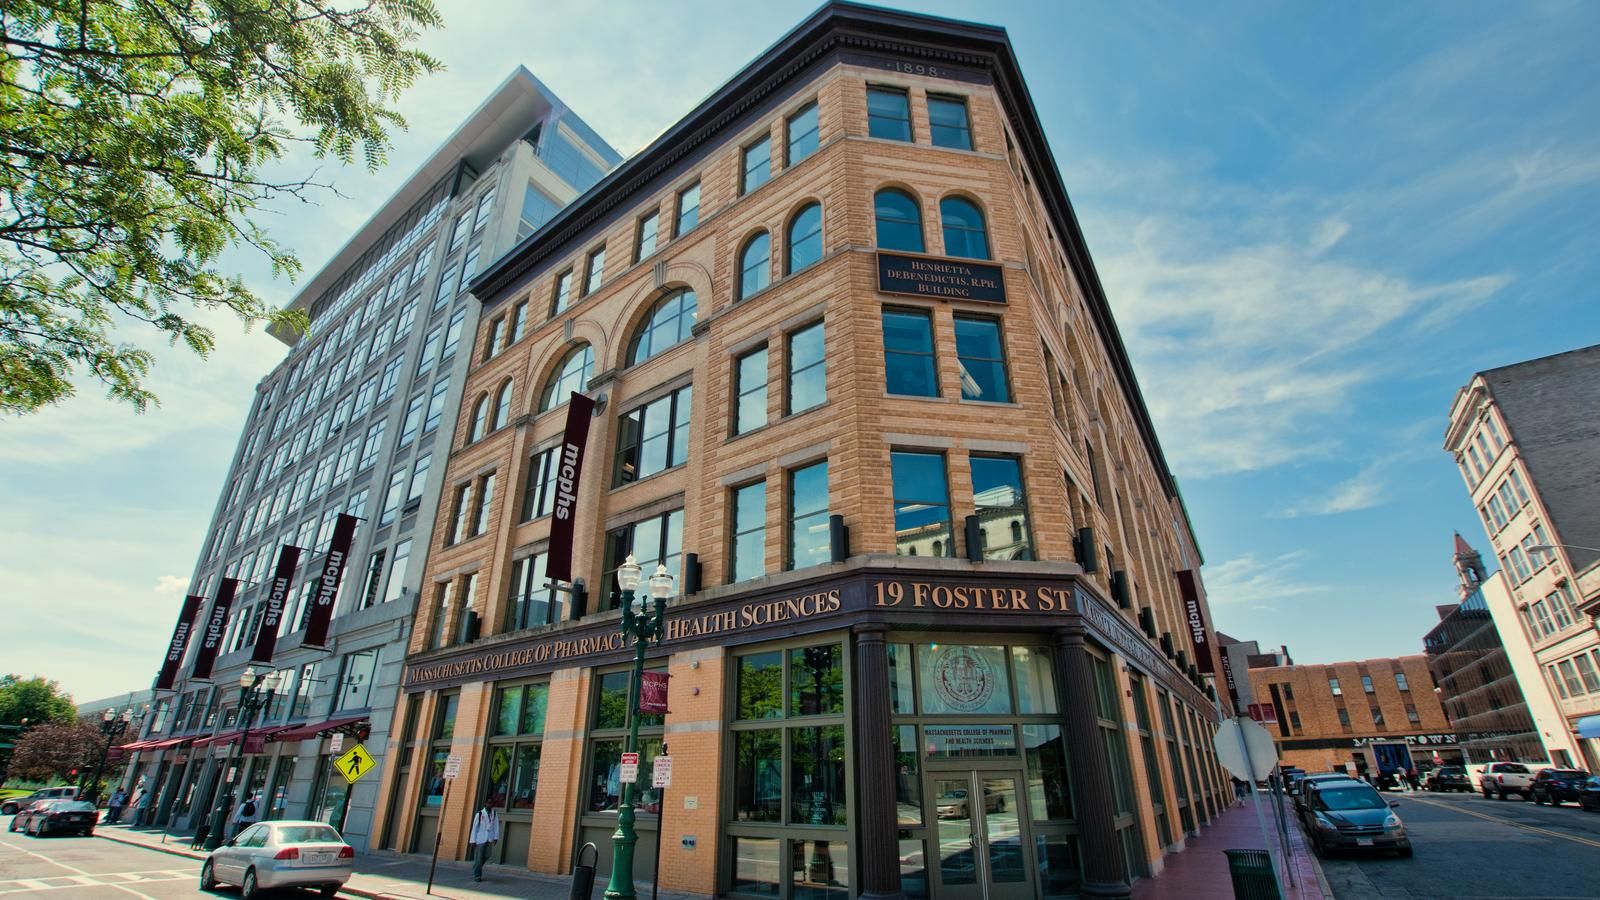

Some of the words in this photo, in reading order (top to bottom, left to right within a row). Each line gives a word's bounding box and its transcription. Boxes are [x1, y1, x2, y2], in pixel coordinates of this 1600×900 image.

[895, 61, 938, 77] 1898
[911, 261, 971, 276] HENRIETTA
[918, 283, 969, 297] BUILDING
[556, 442, 579, 521] mcphs
[318, 550, 344, 606] mcphs
[873, 581, 904, 607] 19
[911, 583, 1031, 610] FOSTER
[1036, 586, 1071, 611] ST
[265, 577, 288, 627] mcphs
[1187, 600, 1205, 644] mcphs
[169, 622, 190, 662] mcphs
[205, 605, 226, 649] mcphs
[411, 658, 484, 683] MASSACHUSETTS
[484, 649, 534, 671] COLLEGE
[534, 643, 554, 661] OF
[554, 631, 626, 659] PHARMACY
[666, 610, 737, 640] HEALTH
[741, 589, 841, 628] SCIENCES
[1221, 656, 1235, 690] MCPHS
